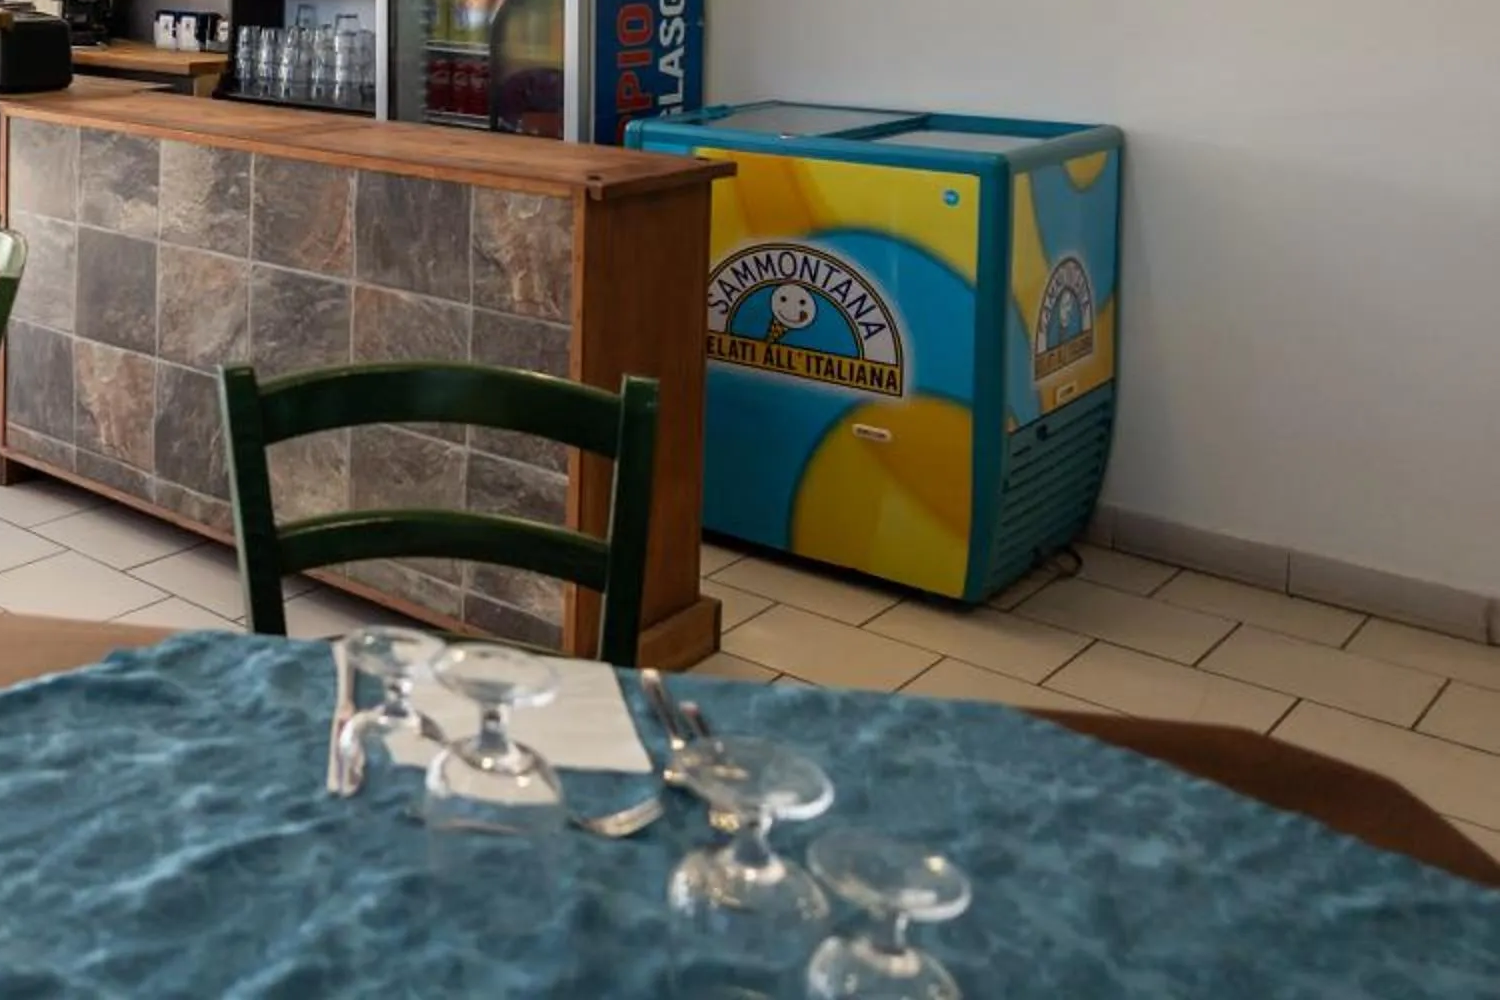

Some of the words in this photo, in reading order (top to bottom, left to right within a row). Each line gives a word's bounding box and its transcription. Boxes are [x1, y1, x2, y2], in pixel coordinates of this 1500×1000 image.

[708, 251, 887, 341] SAMMONTANA
[707, 335, 756, 363] ELATI
[805, 353, 898, 392] ITALIANA
